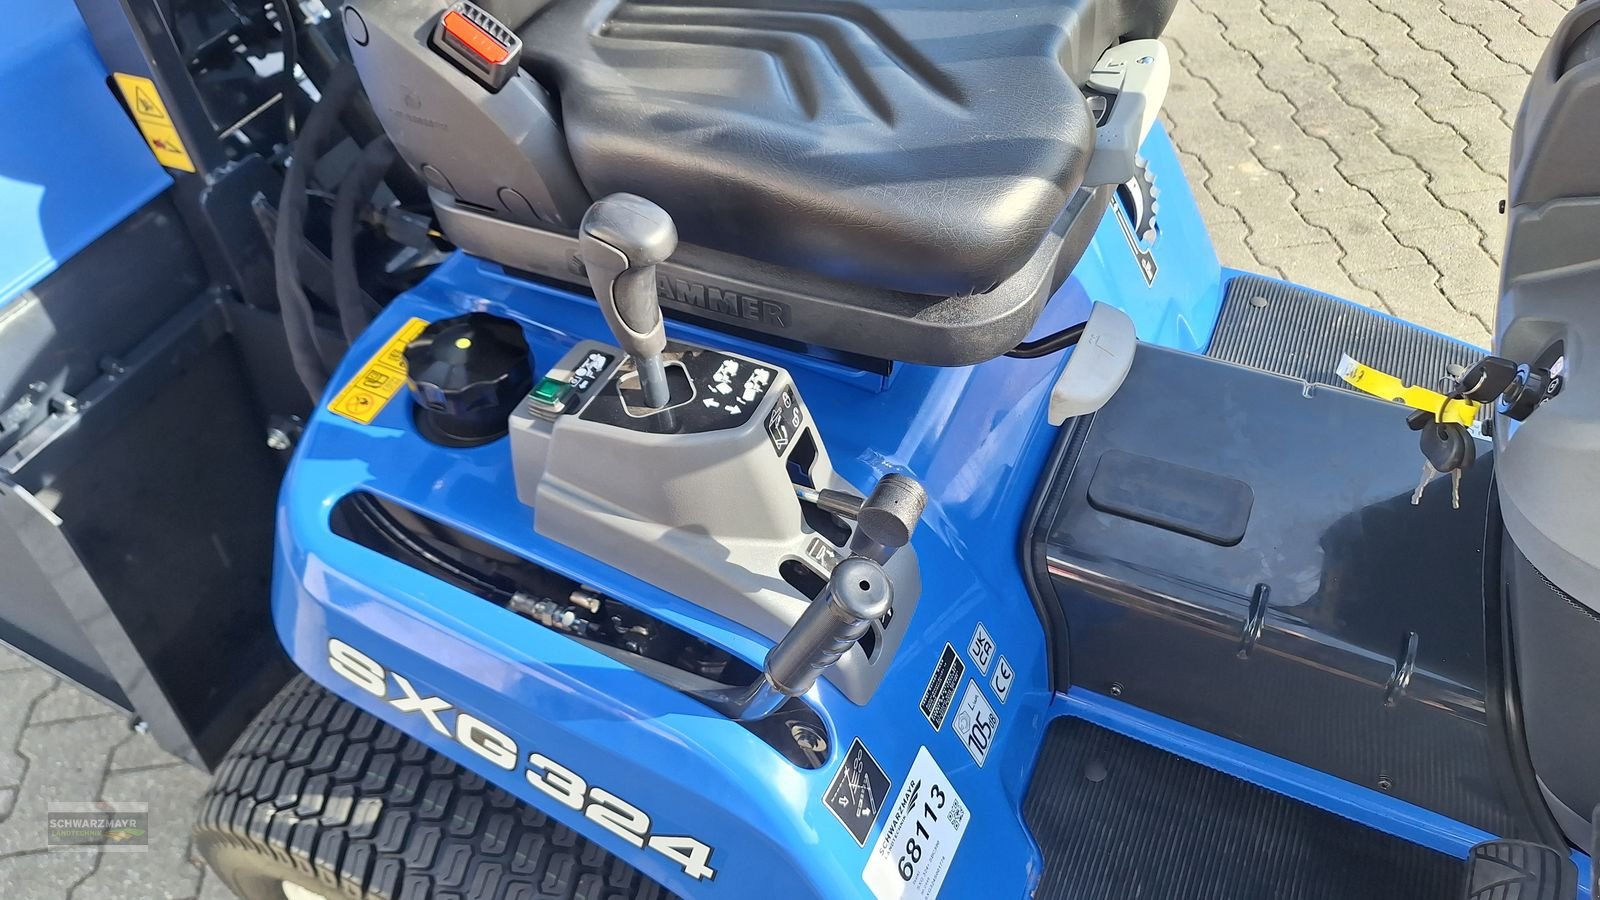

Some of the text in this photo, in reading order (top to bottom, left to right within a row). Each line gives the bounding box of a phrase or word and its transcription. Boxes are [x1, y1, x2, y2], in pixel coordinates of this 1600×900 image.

[656, 275, 786, 328] AMMER
[972, 631, 986, 656] UK
[996, 662, 1011, 693] CE
[327, 637, 718, 882] SXG 324
[968, 711, 992, 756] 105
[879, 779, 916, 856] SCHWARZMAYR
[898, 784, 946, 882] 68113
